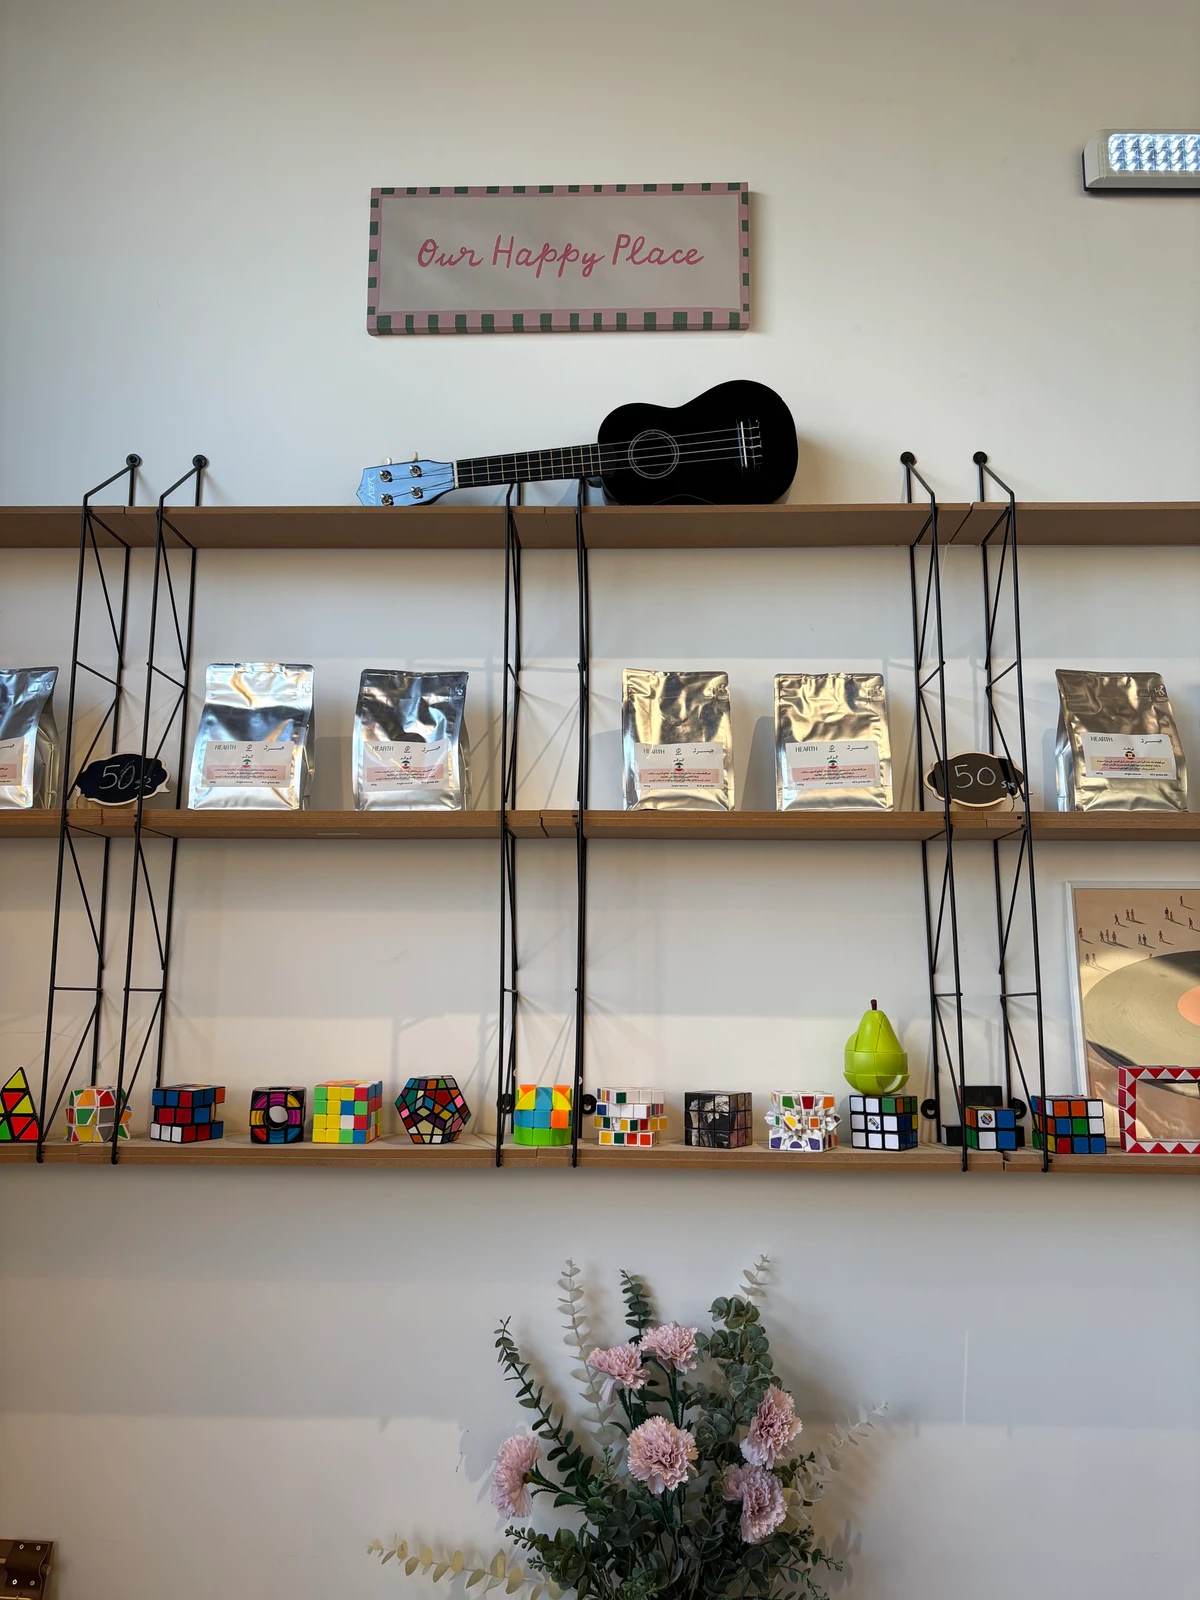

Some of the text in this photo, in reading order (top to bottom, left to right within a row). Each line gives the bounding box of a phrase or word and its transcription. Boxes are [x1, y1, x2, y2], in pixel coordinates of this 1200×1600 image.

[416, 233, 705, 279] Our Happy Place
[794, 745, 819, 753] HEARTH
[954, 763, 997, 789] 50
